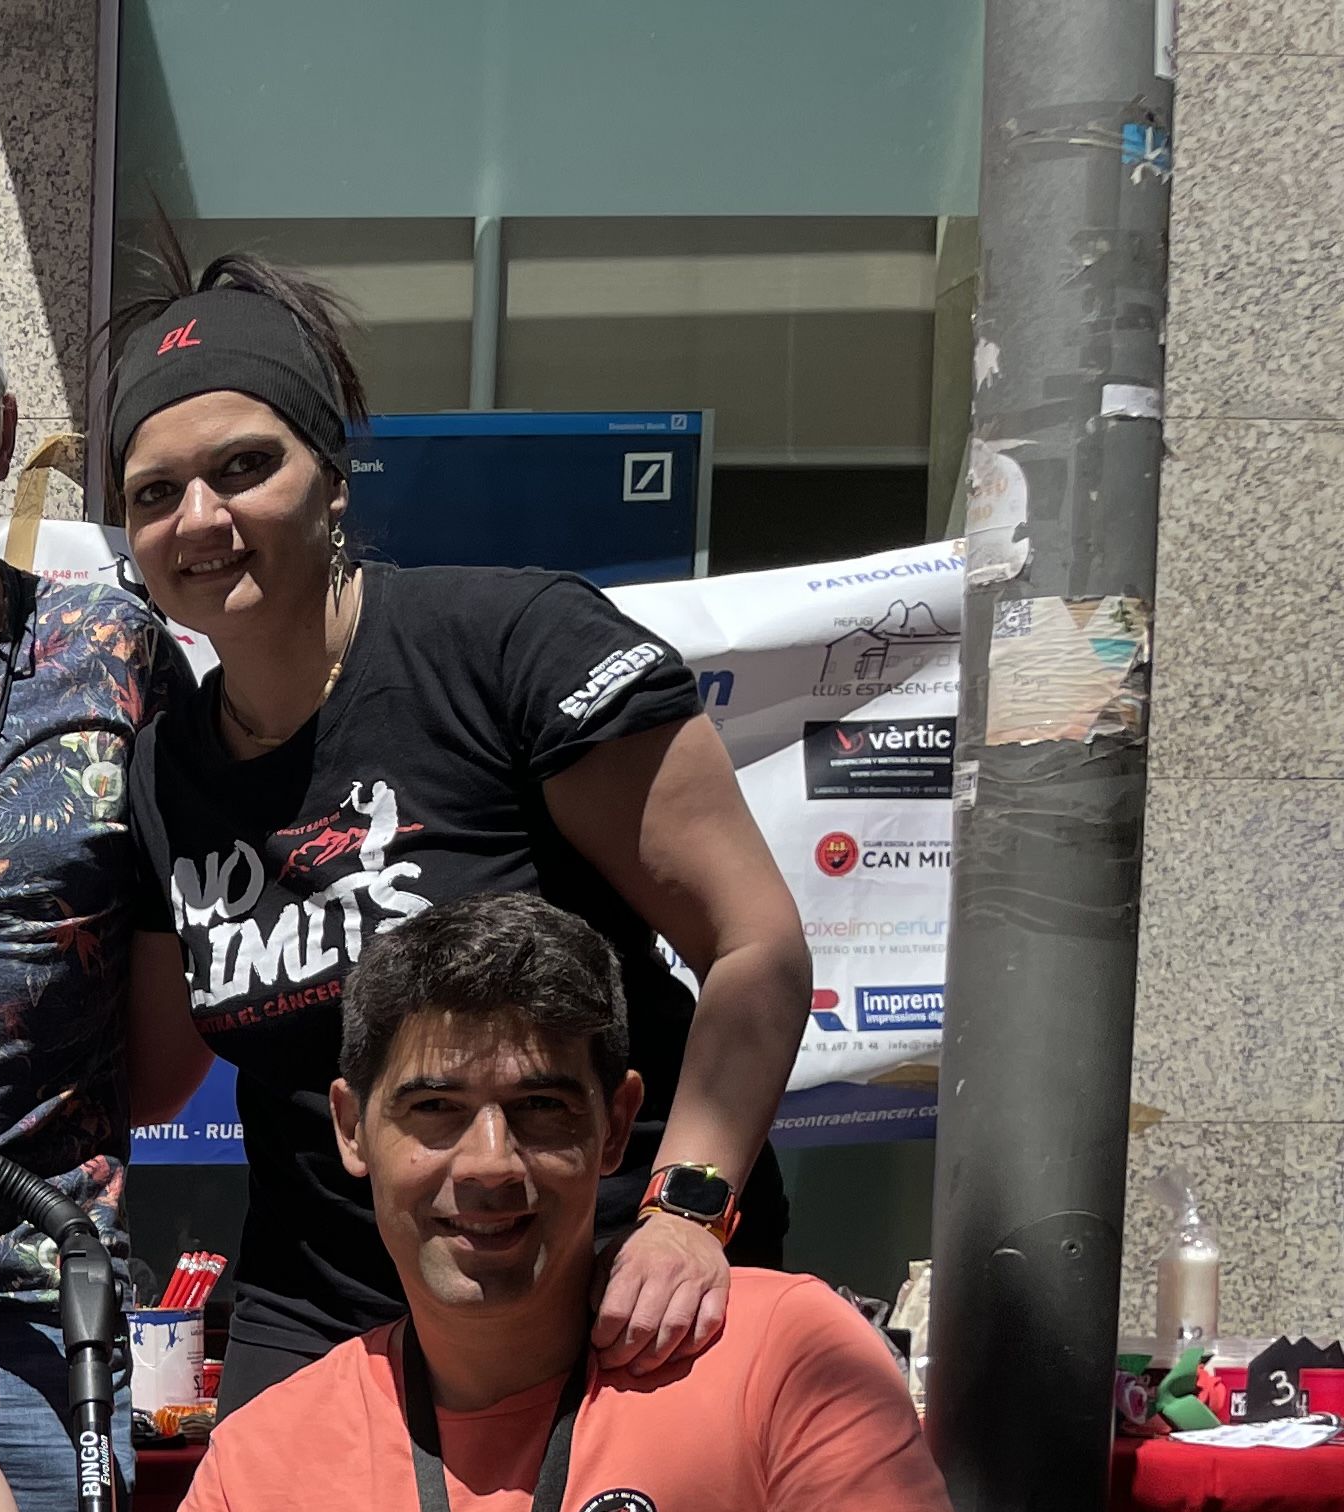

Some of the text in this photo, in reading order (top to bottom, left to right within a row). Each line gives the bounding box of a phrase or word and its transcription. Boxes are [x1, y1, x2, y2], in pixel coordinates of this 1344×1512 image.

[351, 459, 384, 473] Bank
[833, 616, 874, 627] REFUGI
[813, 683, 852, 697] LLUIS
[868, 724, 952, 750] vèrtic
[862, 850, 910, 869] CAN
[170, 839, 265, 935] NO
[238, 1006, 262, 1025] EL
[263, 980, 342, 1017] CÁNCER
[130, 1123, 189, 1140] ANTIL
[1268, 1370, 1296, 1408] 3
[81, 1431, 102, 1498] BINGO
[98, 1434, 111, 1486] Evolution
